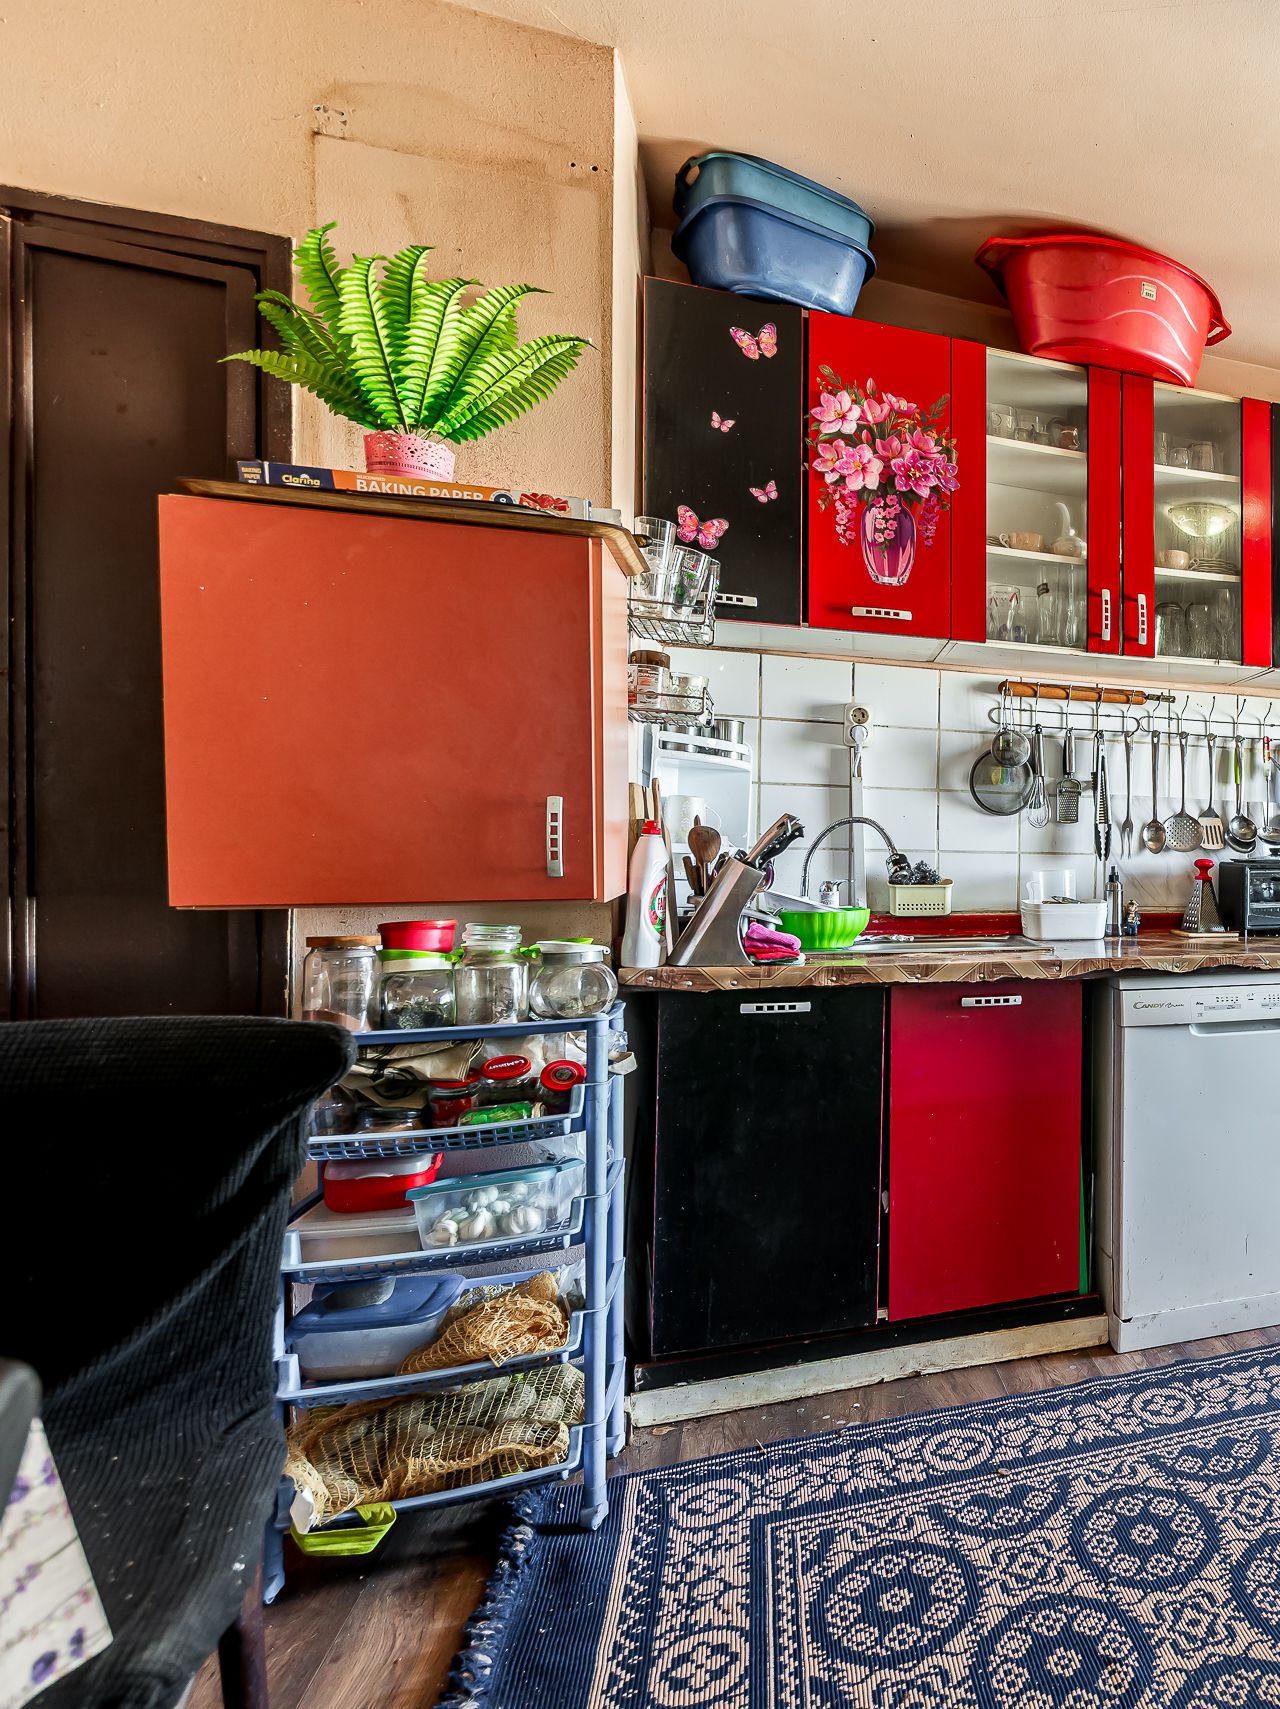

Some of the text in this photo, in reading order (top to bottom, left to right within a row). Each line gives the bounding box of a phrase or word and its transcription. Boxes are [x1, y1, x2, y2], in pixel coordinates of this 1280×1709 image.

[281, 474, 321, 486] Clarina
[356, 479, 484, 501] BAKING PAPER
